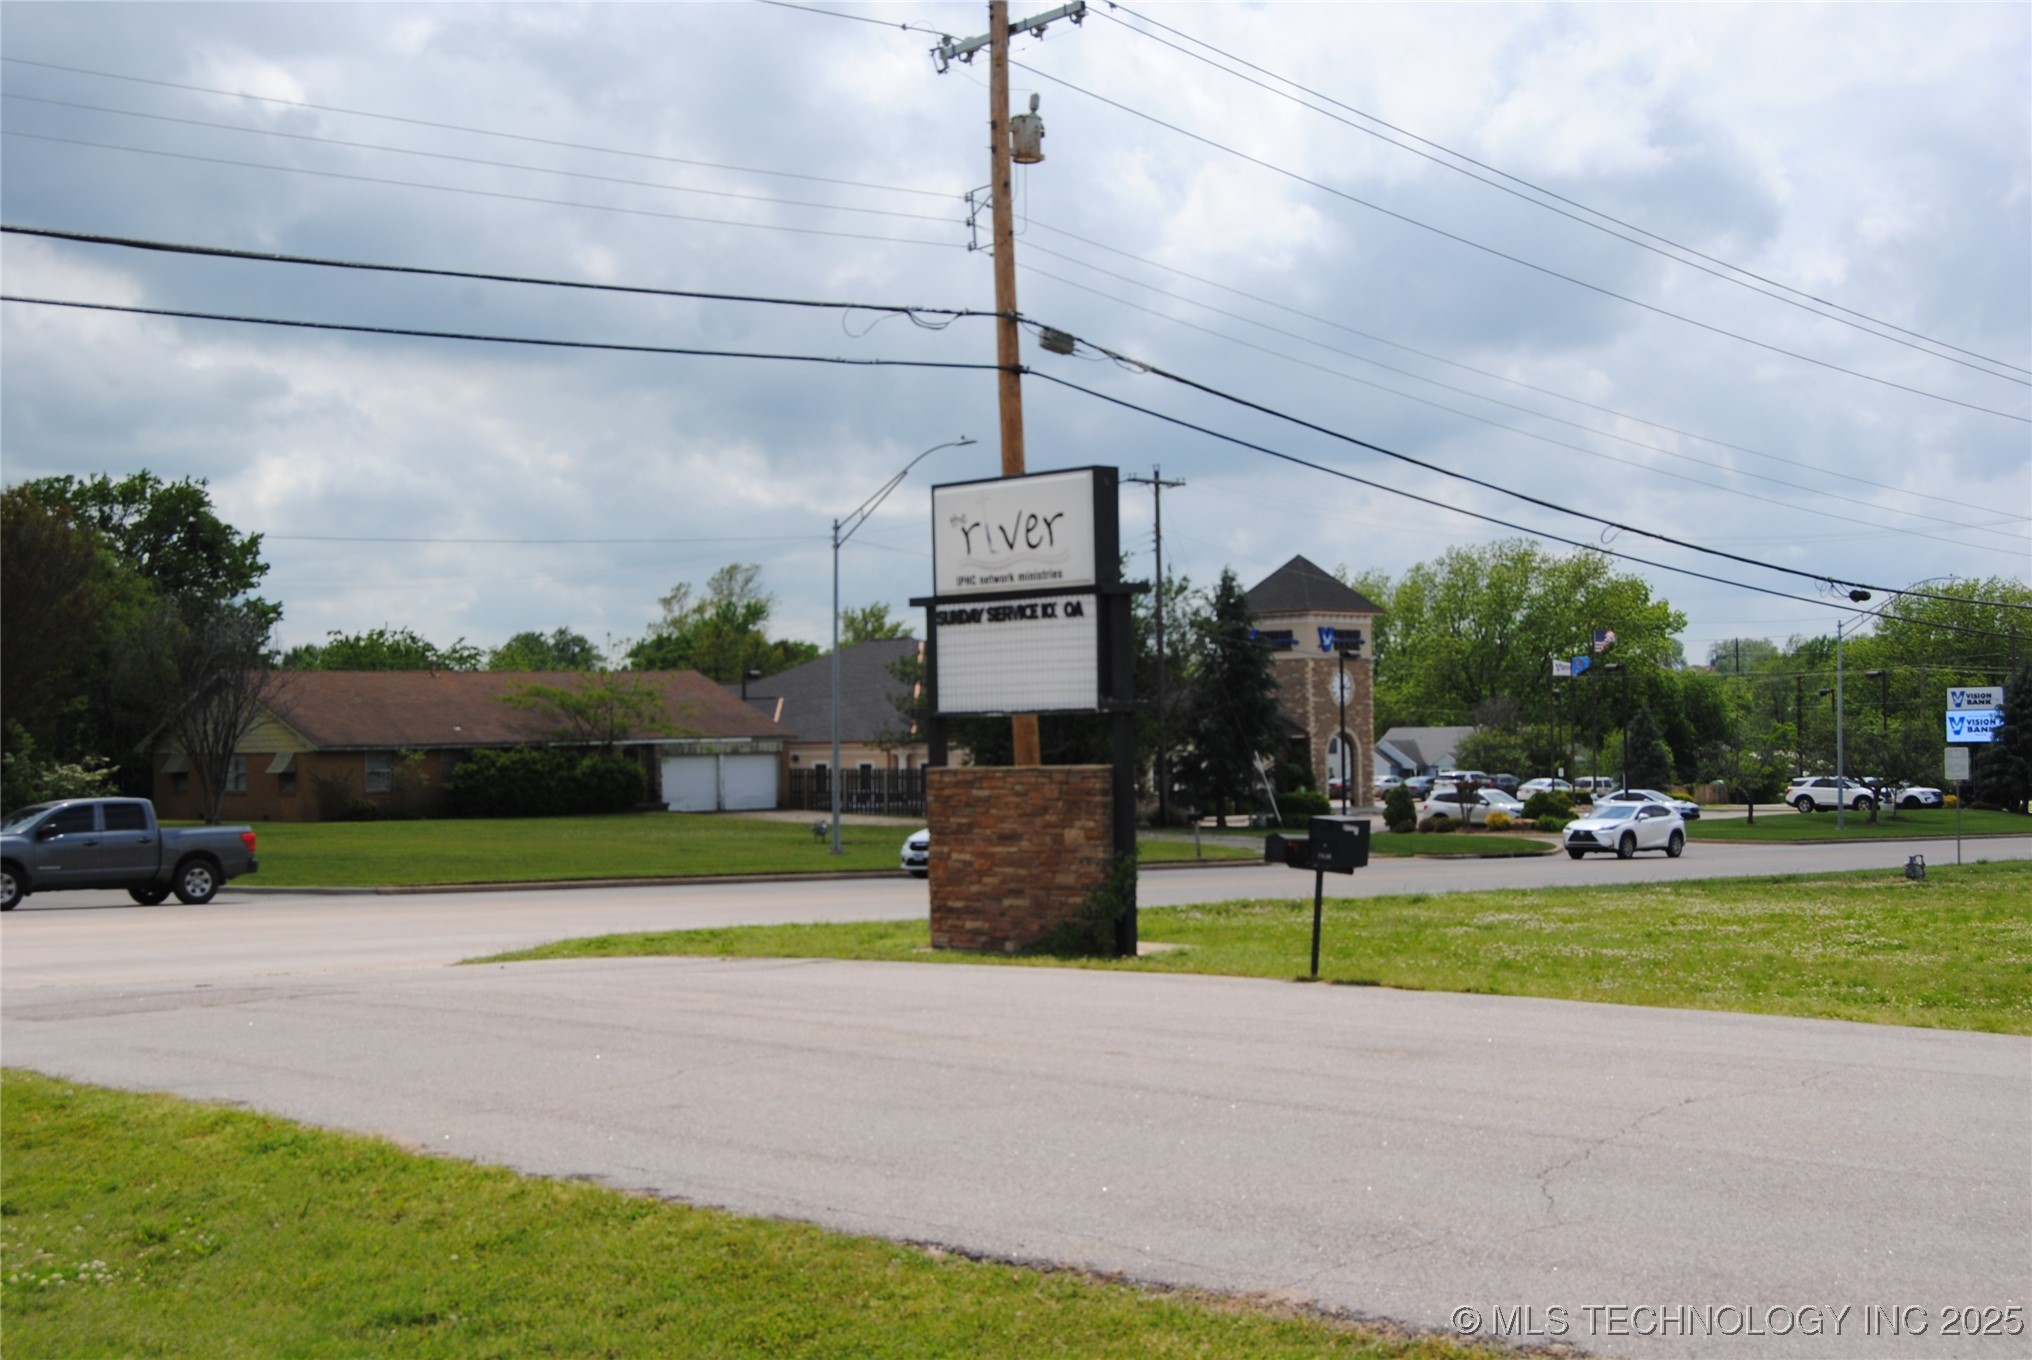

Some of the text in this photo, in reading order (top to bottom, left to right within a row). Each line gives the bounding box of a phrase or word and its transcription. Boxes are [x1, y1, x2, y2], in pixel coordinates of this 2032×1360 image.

[961, 510, 1064, 555] river
[979, 573, 1014, 585] network
[1018, 569, 1063, 581] ministries
[936, 608, 984, 626] SUNDAY
[986, 604, 1039, 622] SERVICE
[1966, 718, 1996, 726] VISION
